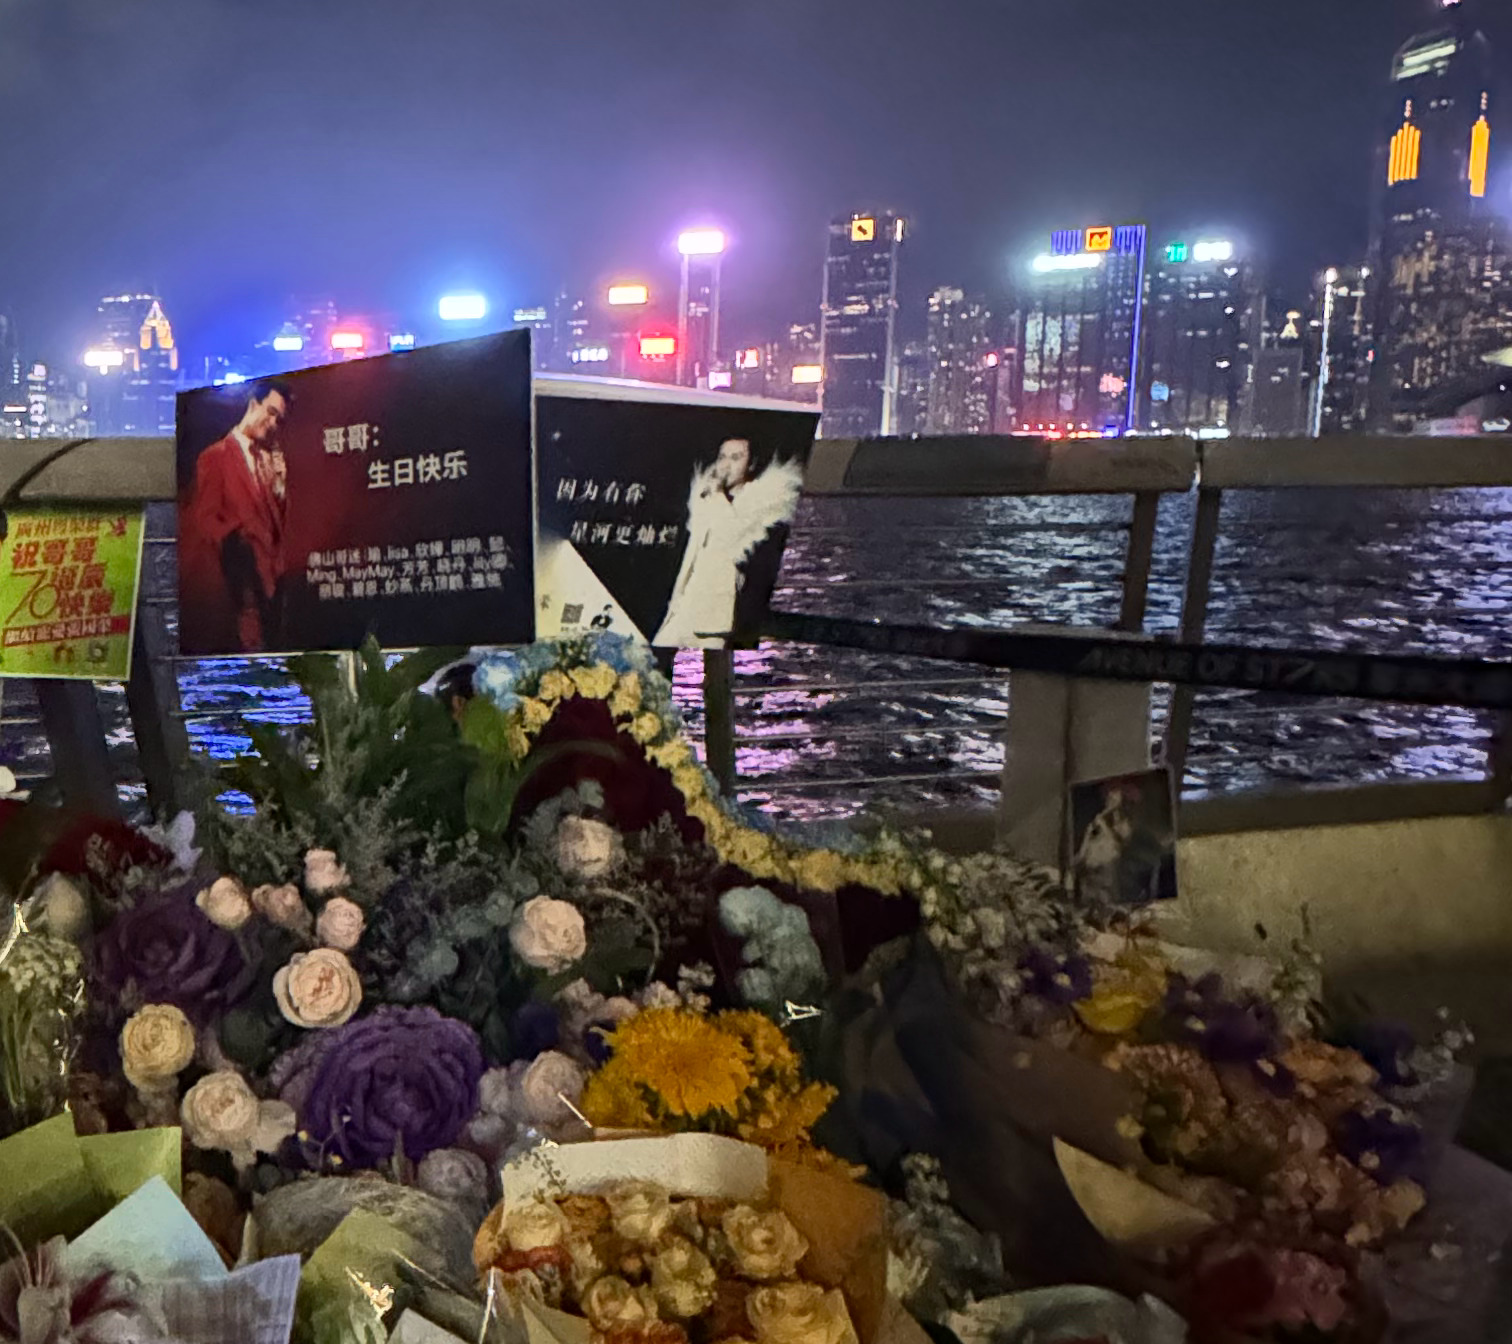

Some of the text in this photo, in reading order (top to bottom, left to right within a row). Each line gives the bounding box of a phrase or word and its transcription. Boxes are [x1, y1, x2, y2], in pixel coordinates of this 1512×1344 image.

[368, 450, 468, 489] 生日快乐
[555, 477, 647, 505] 因为有你
